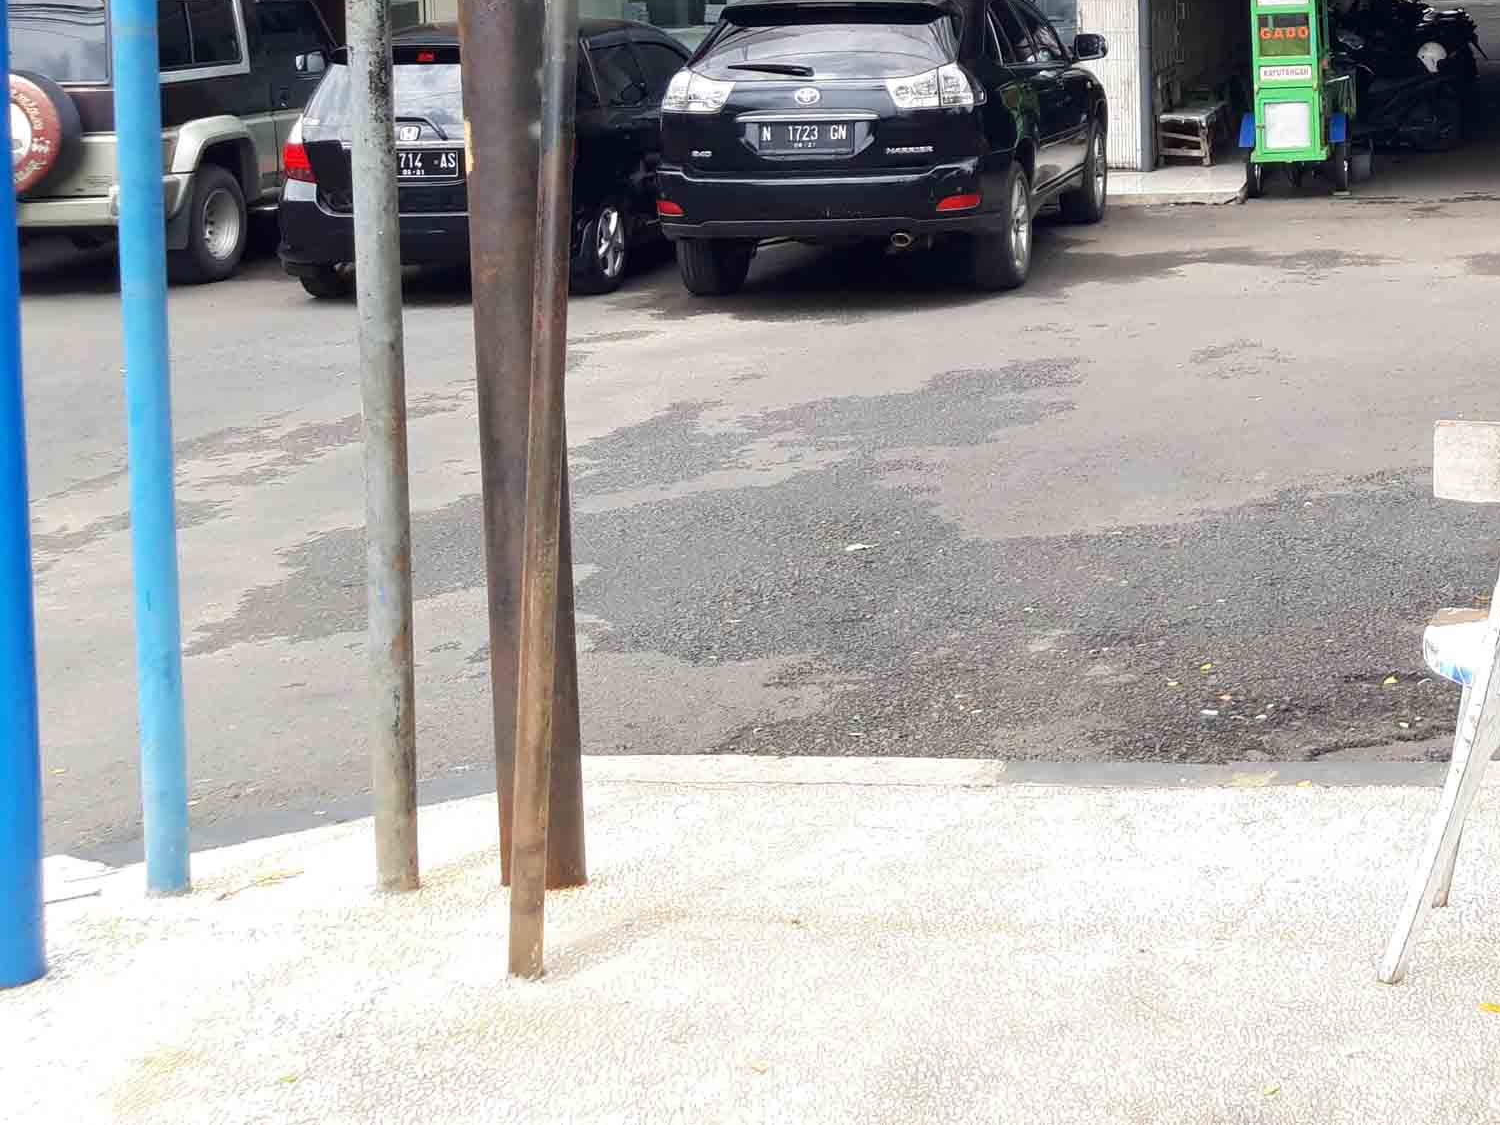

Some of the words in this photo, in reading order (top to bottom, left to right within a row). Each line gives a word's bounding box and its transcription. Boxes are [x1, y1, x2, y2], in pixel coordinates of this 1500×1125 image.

[762, 127, 771, 141] N
[788, 126, 818, 141] 1723
[830, 125, 847, 140] GN
[440, 153, 456, 168] AS
